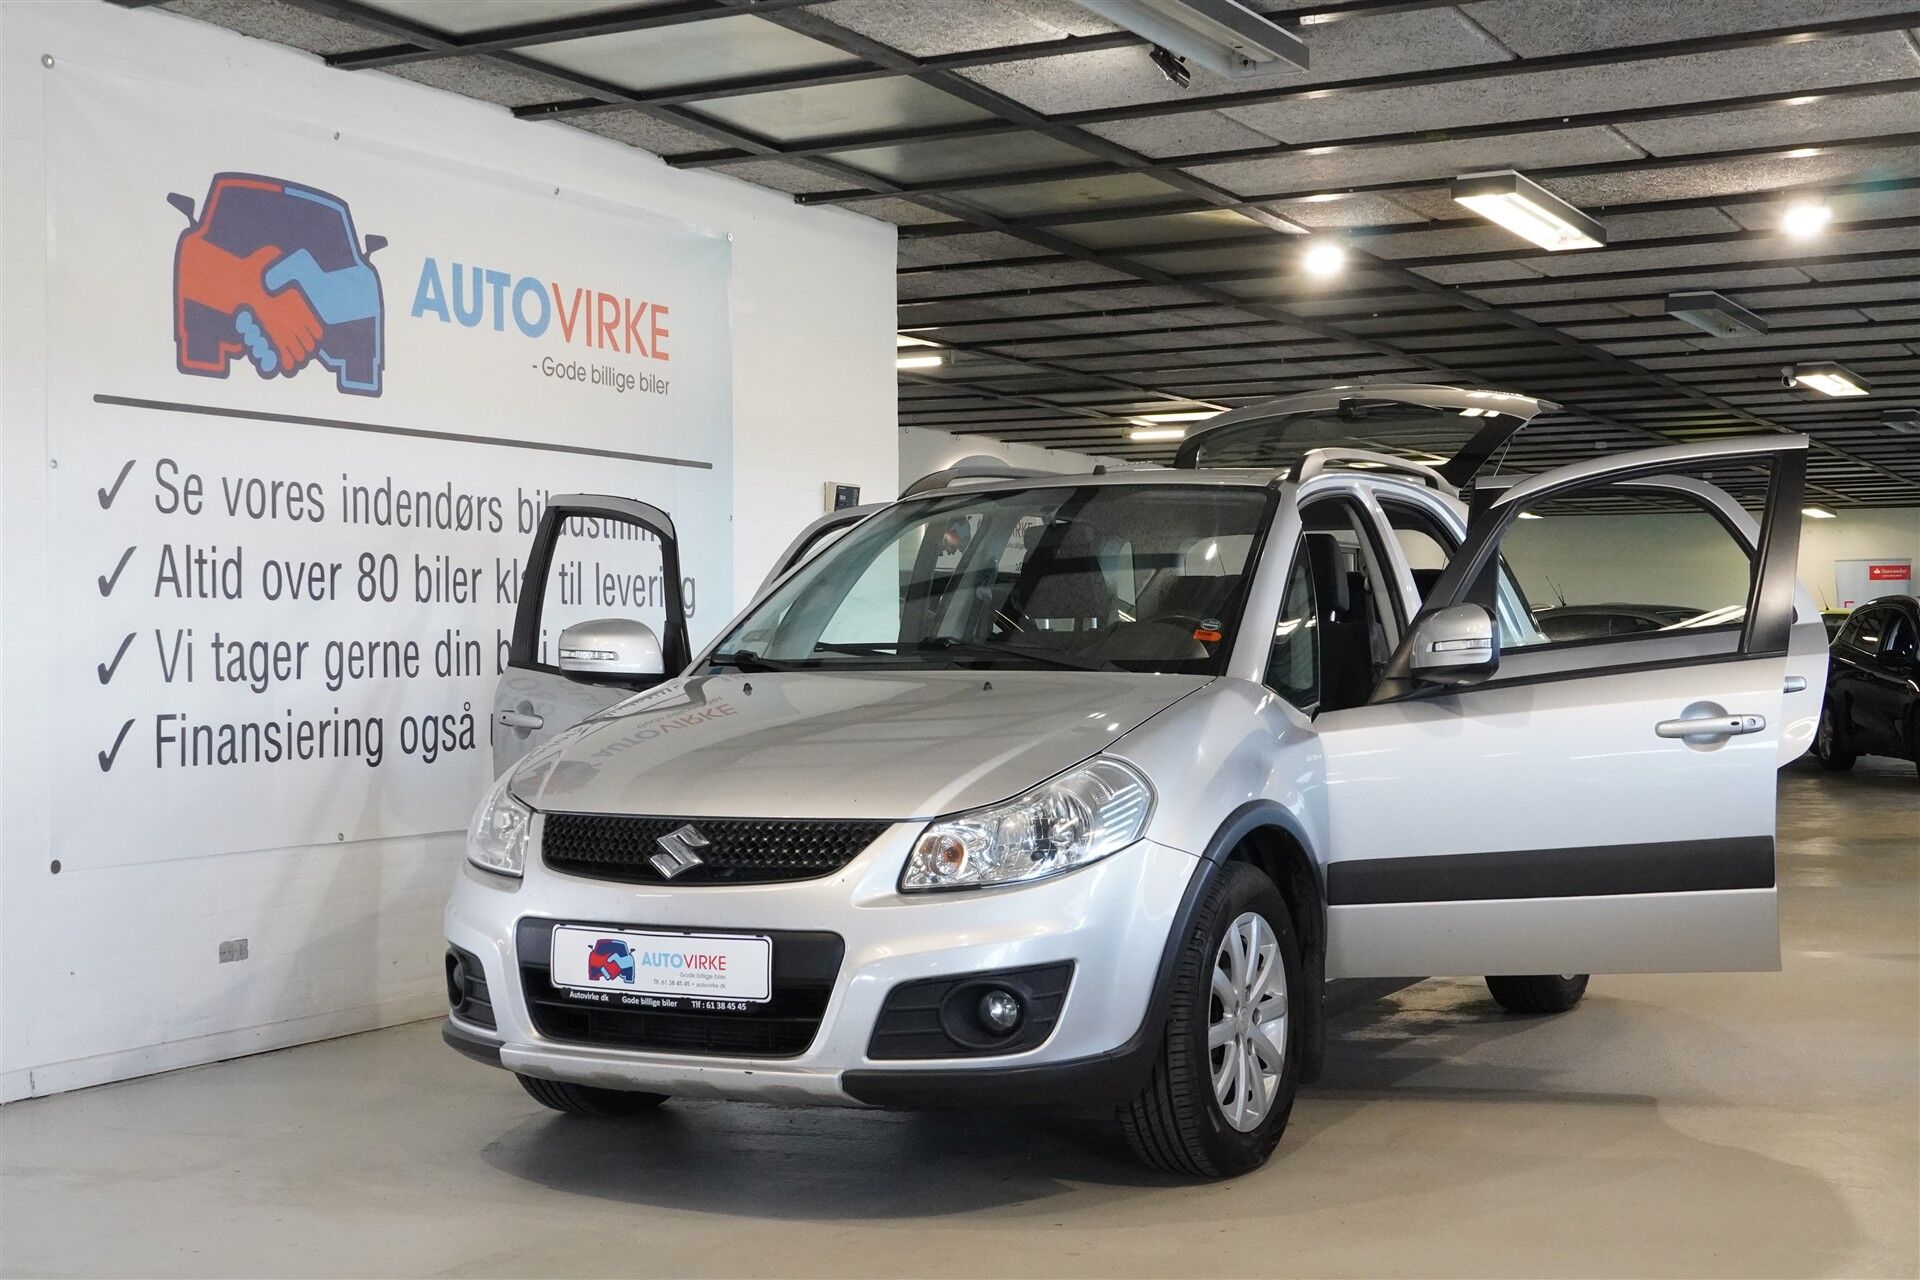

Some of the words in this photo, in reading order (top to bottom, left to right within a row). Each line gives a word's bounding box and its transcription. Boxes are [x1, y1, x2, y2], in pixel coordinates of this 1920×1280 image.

[411, 256, 669, 361] AUTOVIRKE
[542, 356, 586, 382] Gode
[591, 364, 635, 393] billige
[639, 373, 670, 395] biler
[155, 458, 203, 516] Se
[221, 477, 325, 523] vores
[342, 473, 503, 534] indendørs
[154, 544, 242, 600] Altid
[262, 560, 343, 602] over
[357, 551, 399, 603] 80
[414, 553, 483, 604] biler
[558, 560, 582, 606] til
[595, 562, 696, 619] leverig
[155, 628, 193, 683] Vi
[211, 632, 310, 694] tager
[325, 640, 420, 692] gerne
[434, 628, 481, 678] din
[156, 706, 384, 769] Finansiering
[400, 701, 476, 765] også
[641, 951, 727, 971] AUTOVIRKE
[569, 990, 599, 1001] Autovirke
[621, 995, 639, 1004] Gode
[640, 997, 661, 1007] billige
[661, 998, 678, 1007] biler
[706, 1001, 715, 1009] 61
[716, 1002, 726, 1010] 38
[727, 1002, 736, 1010] 45
[737, 1002, 747, 1011] 45
